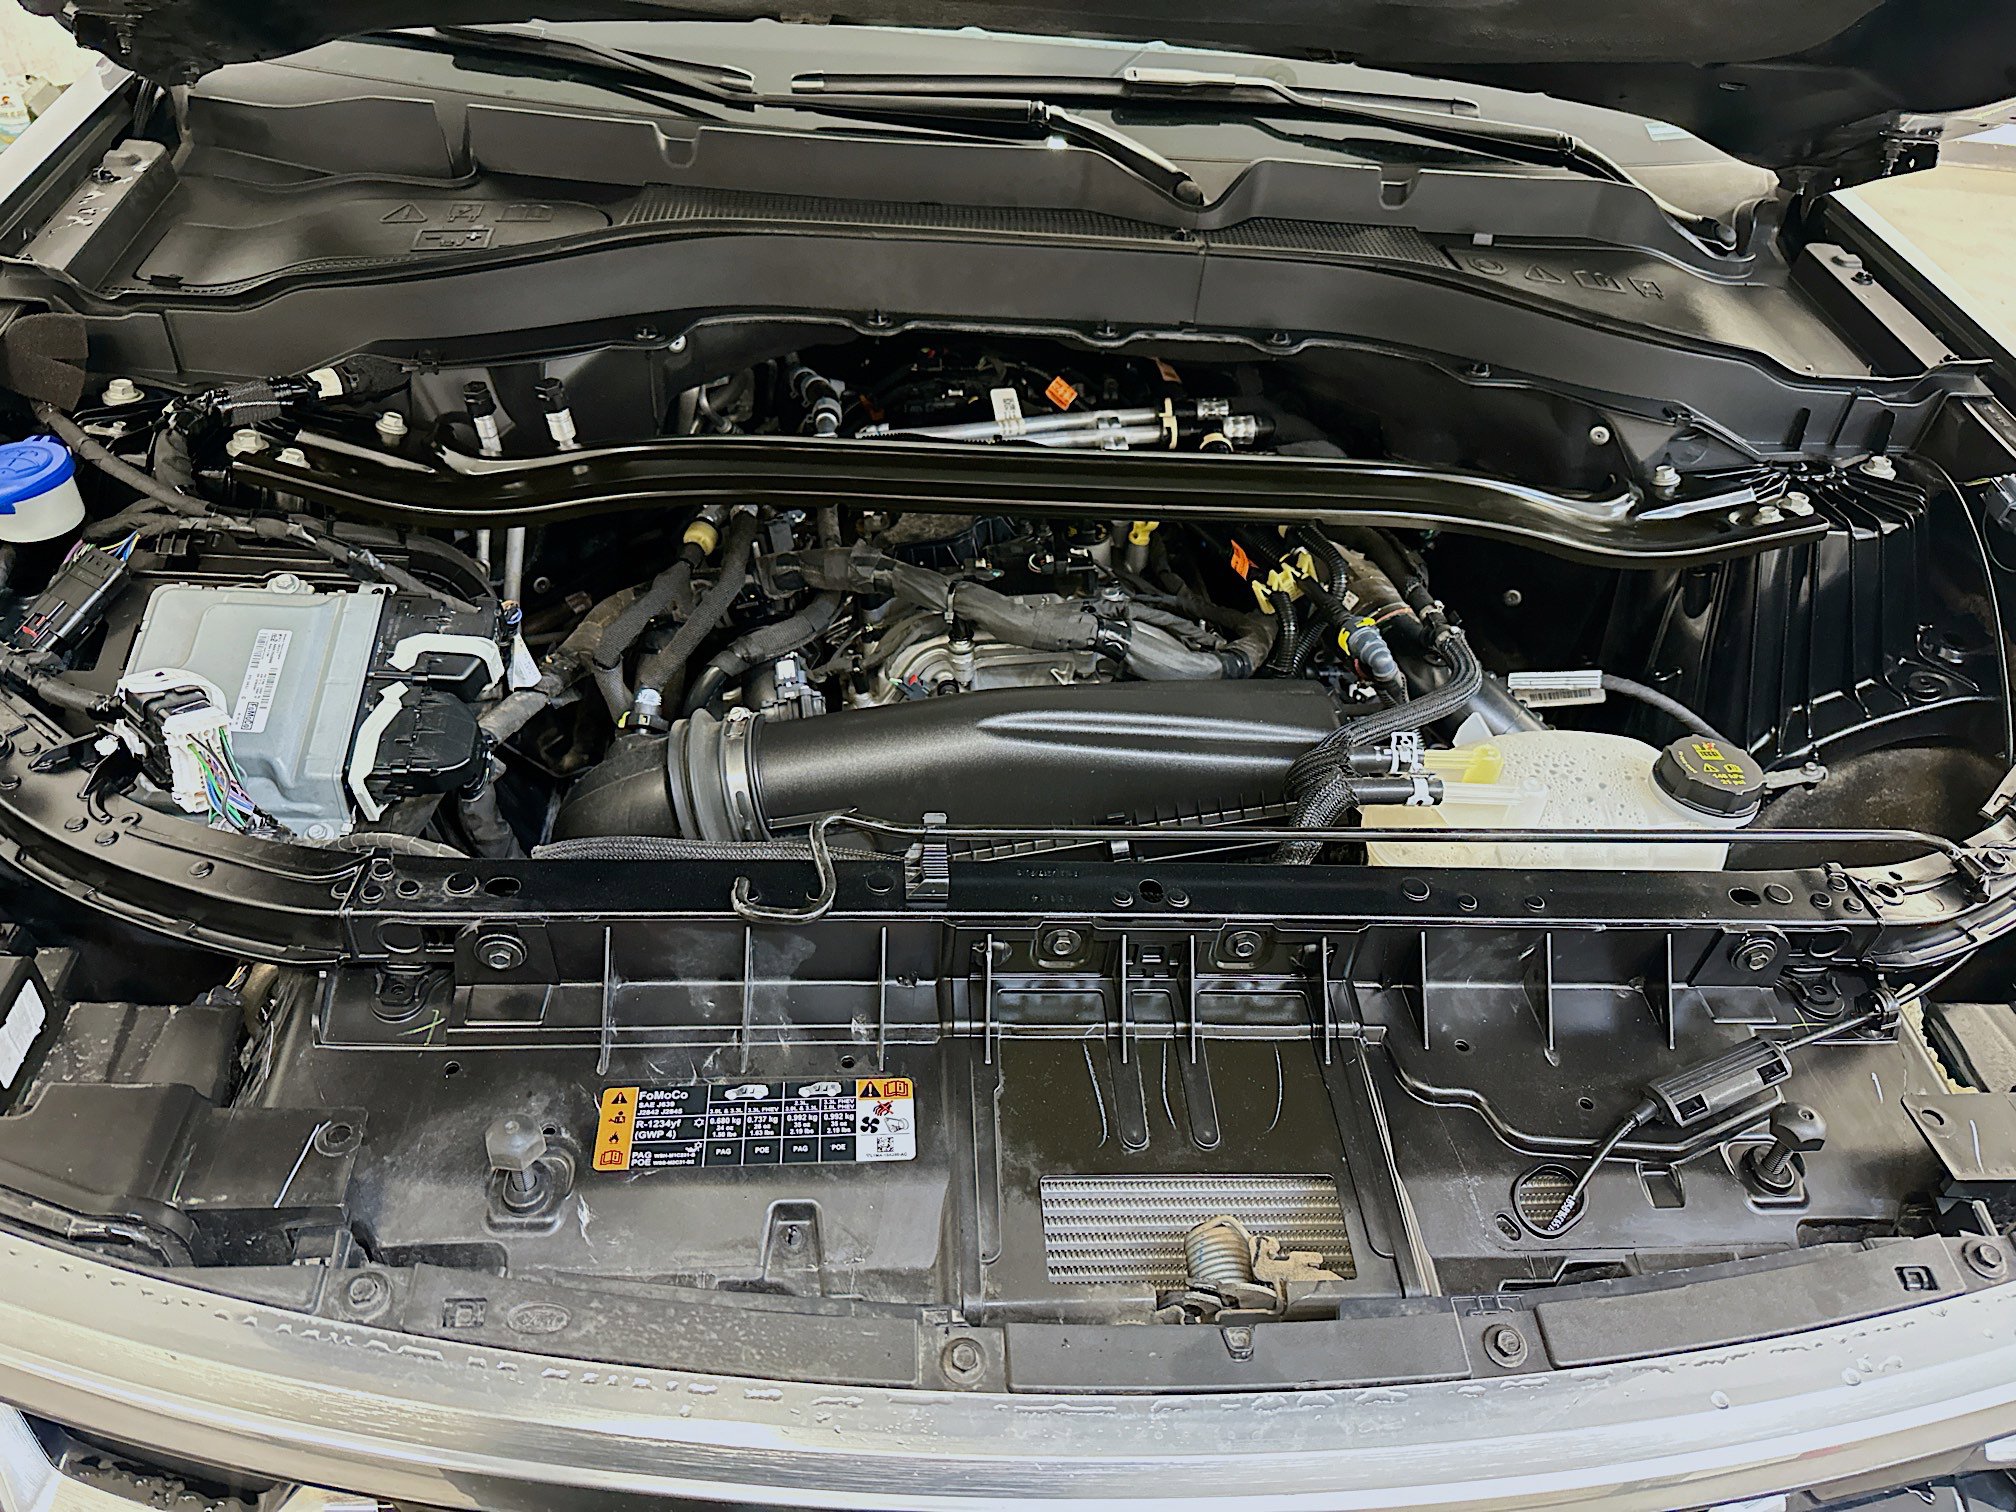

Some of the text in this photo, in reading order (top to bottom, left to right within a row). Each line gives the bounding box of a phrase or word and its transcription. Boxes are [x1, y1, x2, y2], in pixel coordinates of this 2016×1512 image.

[638, 1090, 689, 1101] FoMoCo
[709, 1116, 742, 1125] 0.680 kg
[746, 1115, 778, 1124] 0.737 kg
[786, 1113, 818, 1122] 0.992 kg
[823, 1112, 855, 1121] 0.992 kg
[635, 1119, 682, 1129] R-1234yf
[634, 1129, 677, 1141] (GWP 4)
[715, 1147, 732, 1156] PAG
[754, 1146, 770, 1154] POE
[792, 1145, 809, 1153] PAG
[830, 1143, 847, 1152] POE
[631, 1151, 653, 1159] PAG
[630, 1158, 652, 1167] POE
